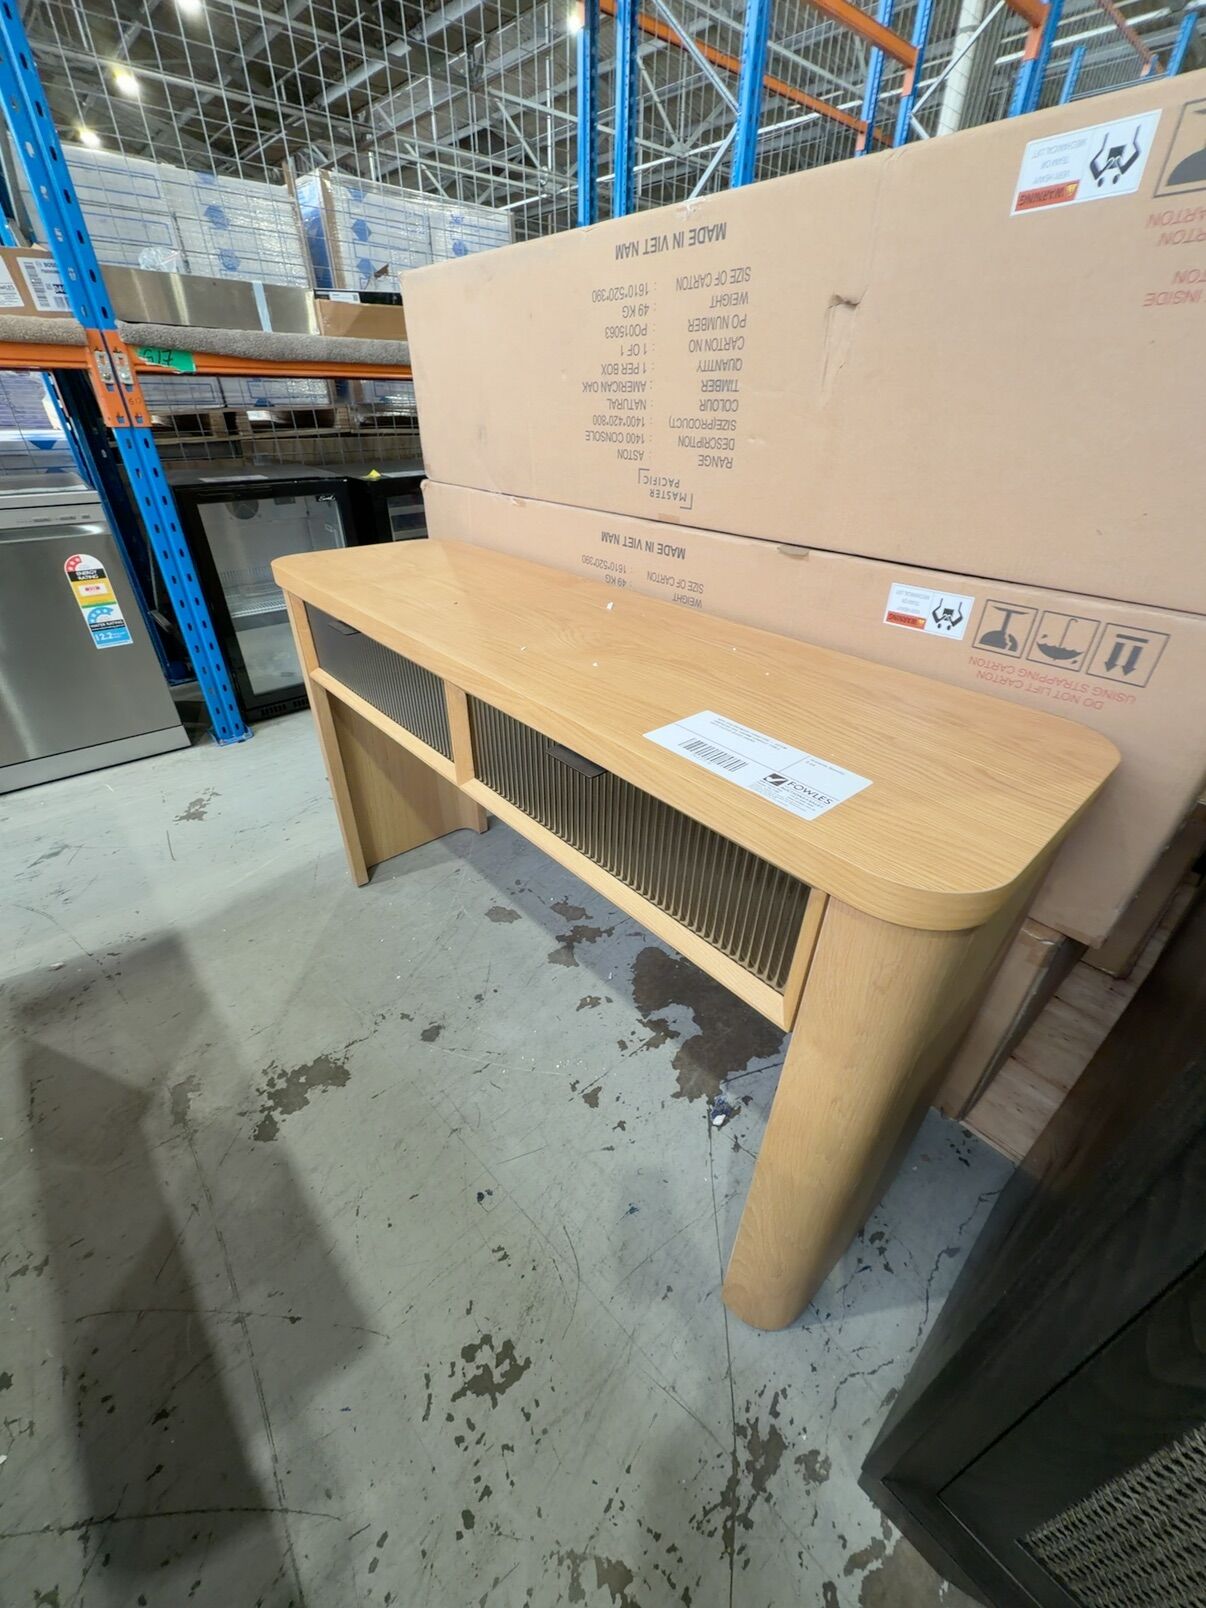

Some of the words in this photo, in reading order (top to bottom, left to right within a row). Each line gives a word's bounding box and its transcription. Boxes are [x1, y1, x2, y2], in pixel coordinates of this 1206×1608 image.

[1017, 186, 1065, 206] WARNING
[672, 231, 684, 249] IN
[688, 222, 727, 246] MADE
[615, 240, 639, 260] NAM
[643, 234, 669, 255] VIET
[676, 271, 711, 292] CARTON
[714, 270, 727, 286] OF
[730, 266, 751, 284] SIZE
[709, 291, 749, 309] WEIGHT
[1143, 290, 1203, 307] INSIDE
[622, 305, 636, 319] KG
[638, 303, 650, 316] 49
[687, 316, 728, 333] NUMBER
[732, 313, 747, 329] PO
[627, 344, 641, 356] OF
[643, 343, 647, 355] 1
[688, 339, 703, 353] NO
[704, 335, 745, 351] CARTON
[620, 345, 624, 357] 1
[601, 363, 620, 375] BOX
[621, 363, 640, 375] PER
[696, 358, 743, 373] QUANTITY
[582, 381, 599, 393] OAK
[601, 380, 646, 393] AMERICAN
[701, 379, 740, 393] TIMBER
[606, 399, 646, 410] NATURAL
[699, 399, 739, 412] COLOUR
[669, 415, 737, 431] SIZE(PRODUCT)
[585, 430, 624, 442] CONSOLE
[625, 432, 645, 444] 1400
[678, 435, 735, 451] DESCRIPTION
[617, 448, 644, 461] ASTON
[698, 454, 733, 469] RANGE
[642, 475, 680, 489] PACIFIC
[649, 488, 687, 502] MASTER
[601, 531, 620, 545] NAM
[622, 536, 643, 550] VIET
[645, 540, 655, 553] IN
[657, 543, 686, 560] MADE
[605, 574, 617, 585] KG
[617, 577, 627, 587] 49
[646, 570, 675, 586] CARTON
[676, 579, 686, 589] OF
[687, 580, 704, 594] SIZE
[672, 592, 702, 608] WEIGHT
[968, 656, 1016, 675] CARTON
[976, 671, 1024, 689] CARTON
[1018, 667, 1090, 694] STRAPPING
[1025, 683, 1051, 696] LIFT
[1092, 687, 1137, 705] USING
[1053, 690, 1080, 704] NOT
[1083, 697, 1104, 710] DO
[787, 780, 833, 806] FOWLES
